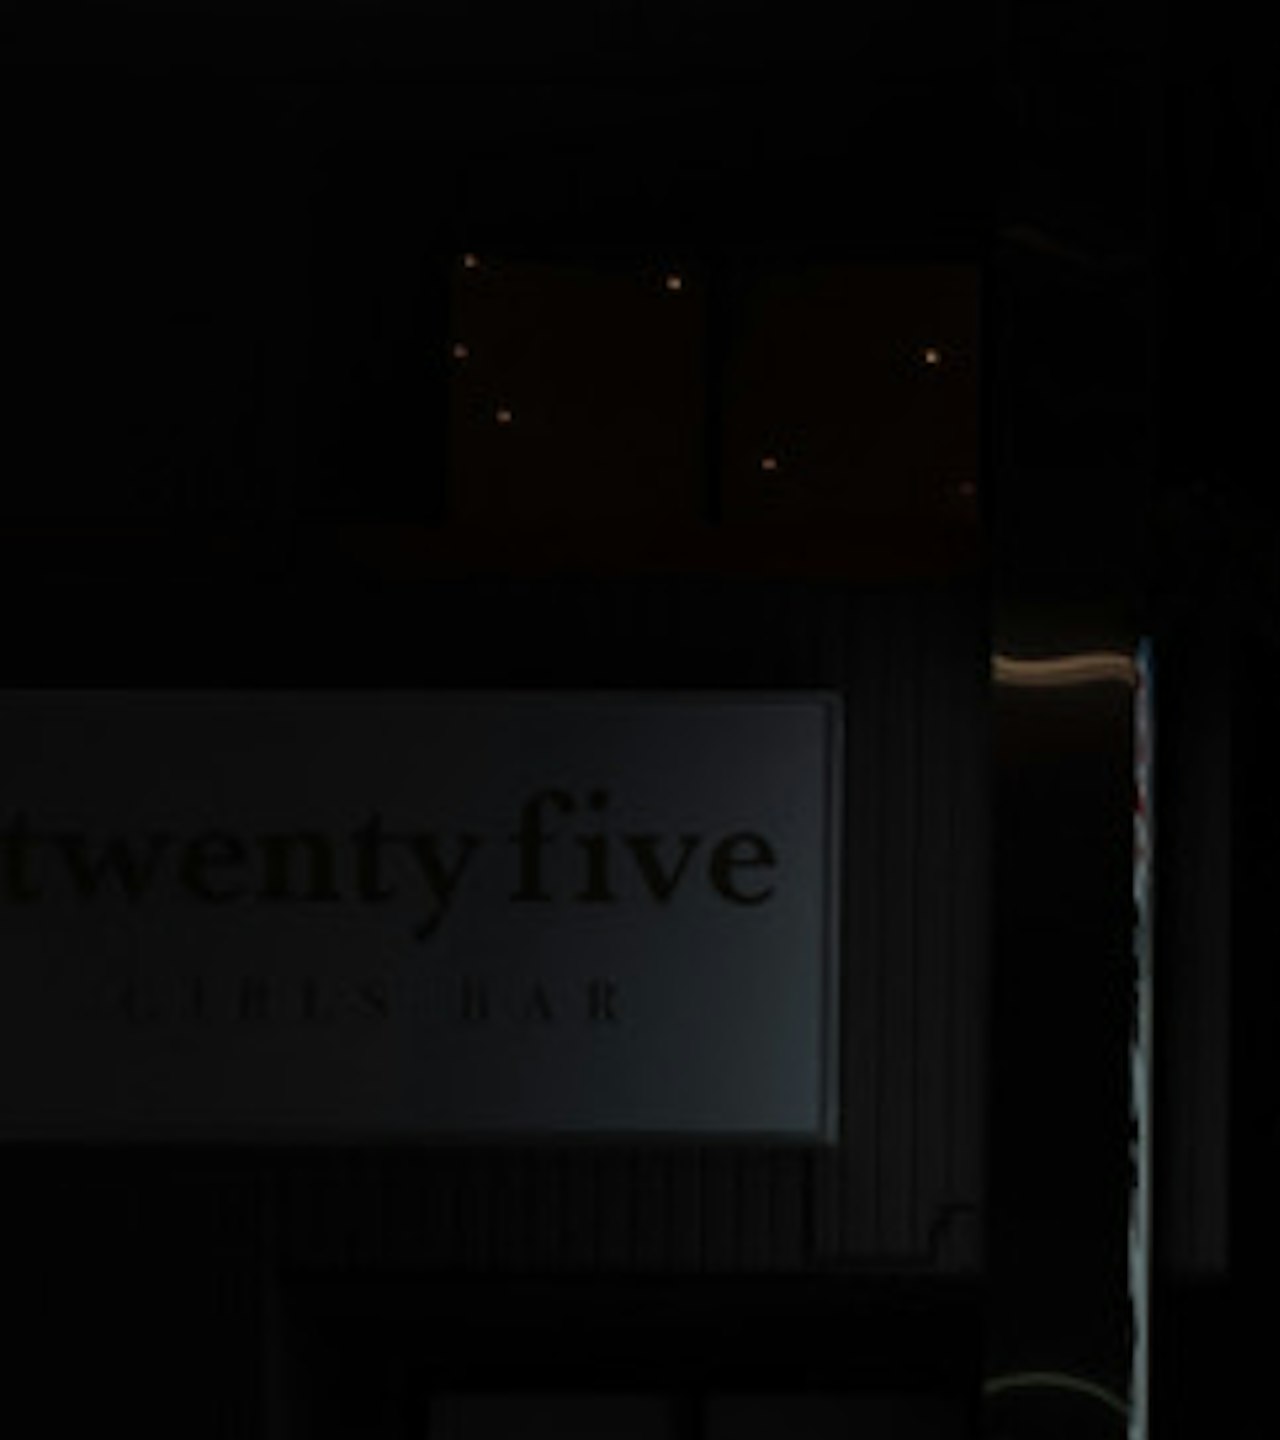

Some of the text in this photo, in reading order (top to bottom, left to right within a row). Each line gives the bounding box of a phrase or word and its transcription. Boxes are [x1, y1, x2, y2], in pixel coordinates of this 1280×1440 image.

[0, 786, 778, 942] twenty five
[118, 976, 626, 1023] GIRLS BAR
